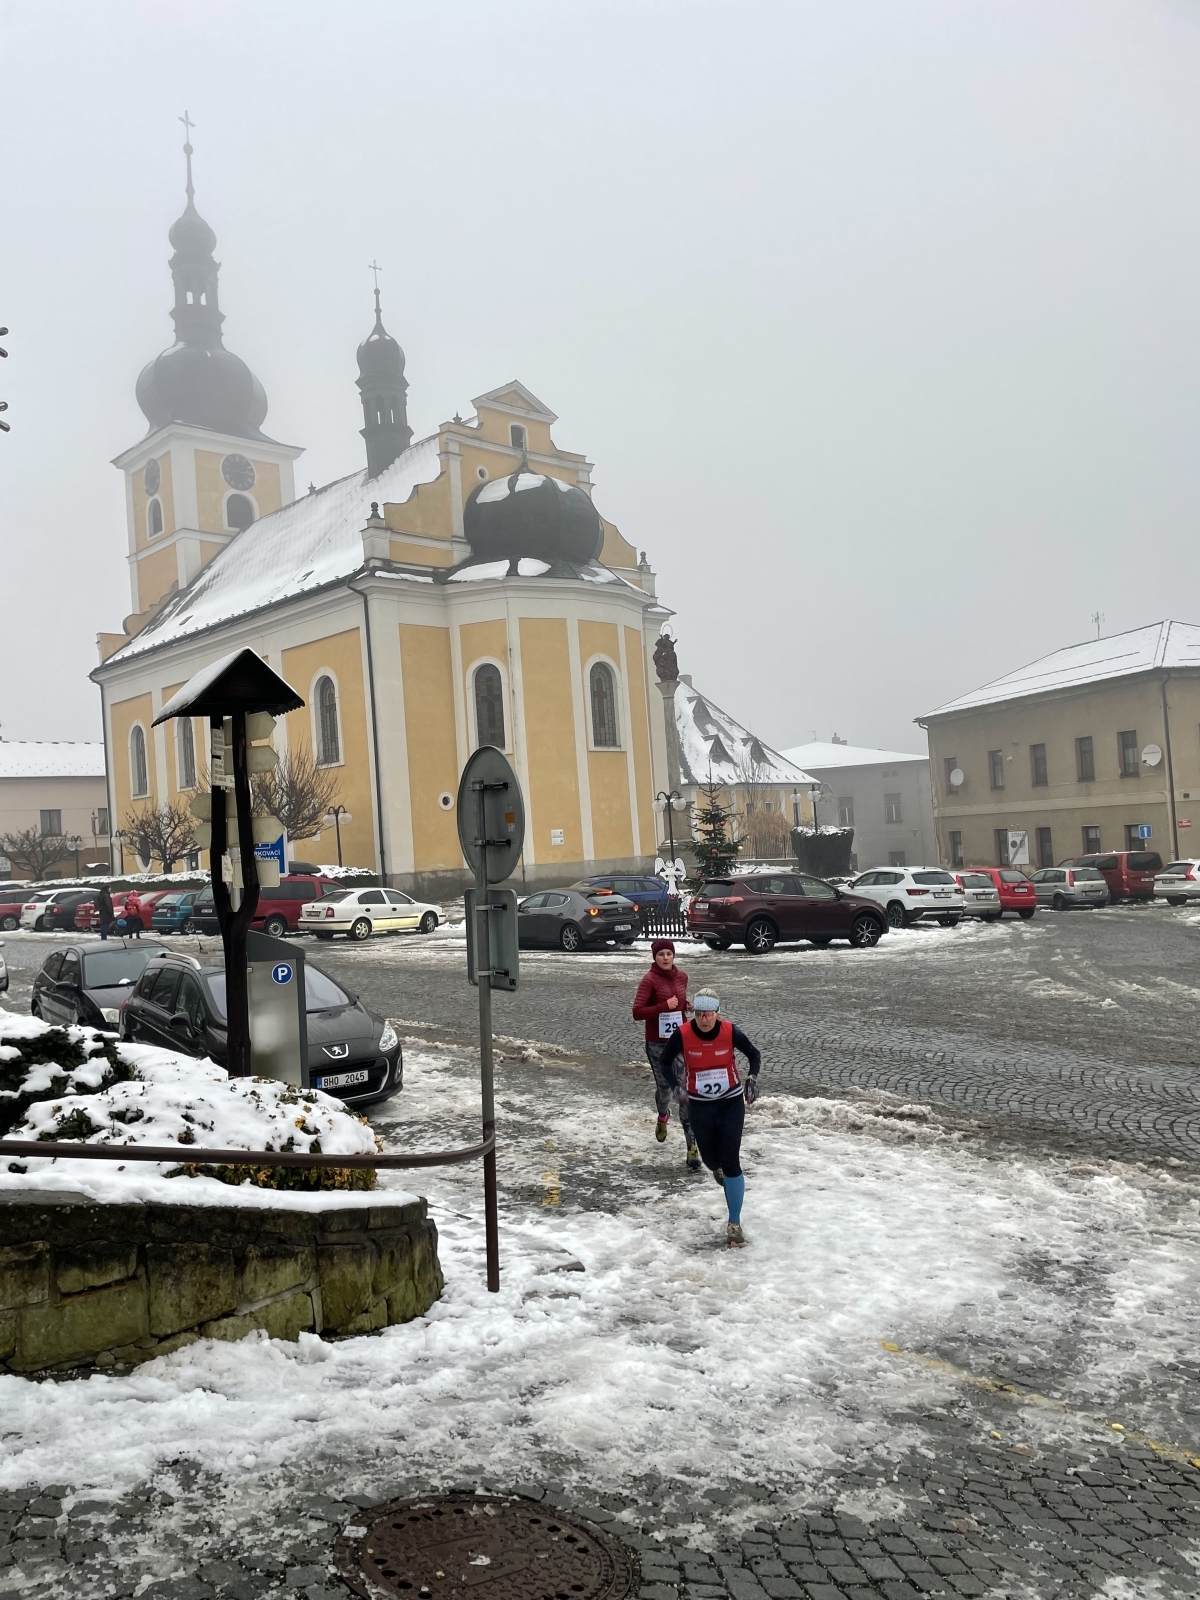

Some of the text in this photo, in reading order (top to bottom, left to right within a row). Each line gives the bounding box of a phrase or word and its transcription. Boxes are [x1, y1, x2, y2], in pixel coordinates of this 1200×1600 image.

[277, 967, 288, 981] P
[665, 1022, 678, 1033] 29
[345, 1071, 365, 1084] 2045
[703, 1083, 722, 1095] 22
